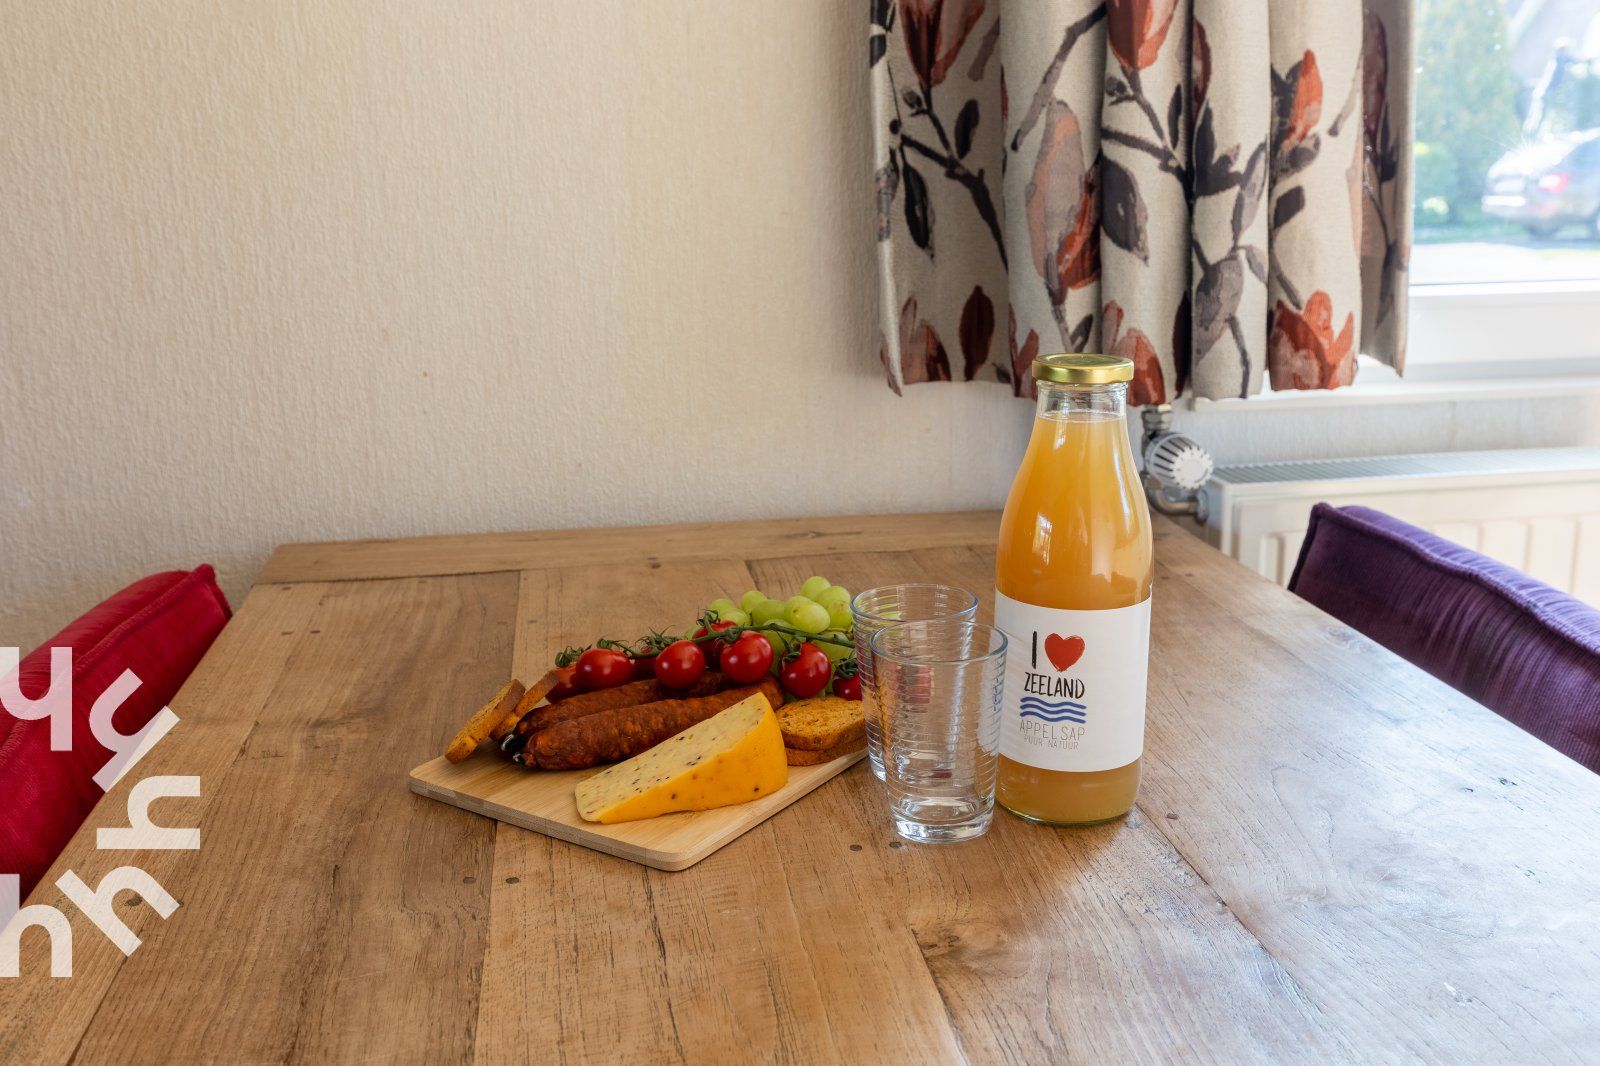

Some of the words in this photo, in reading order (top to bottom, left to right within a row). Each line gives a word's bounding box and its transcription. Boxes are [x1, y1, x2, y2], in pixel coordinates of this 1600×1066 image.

[1031, 630, 1038, 670] I
[1024, 672, 1085, 699] ZEELAND
[1019, 719, 1085, 741] APPELSAP
[1023, 734, 1043, 747] PUUR
[1048, 739, 1079, 750] NATUUR
